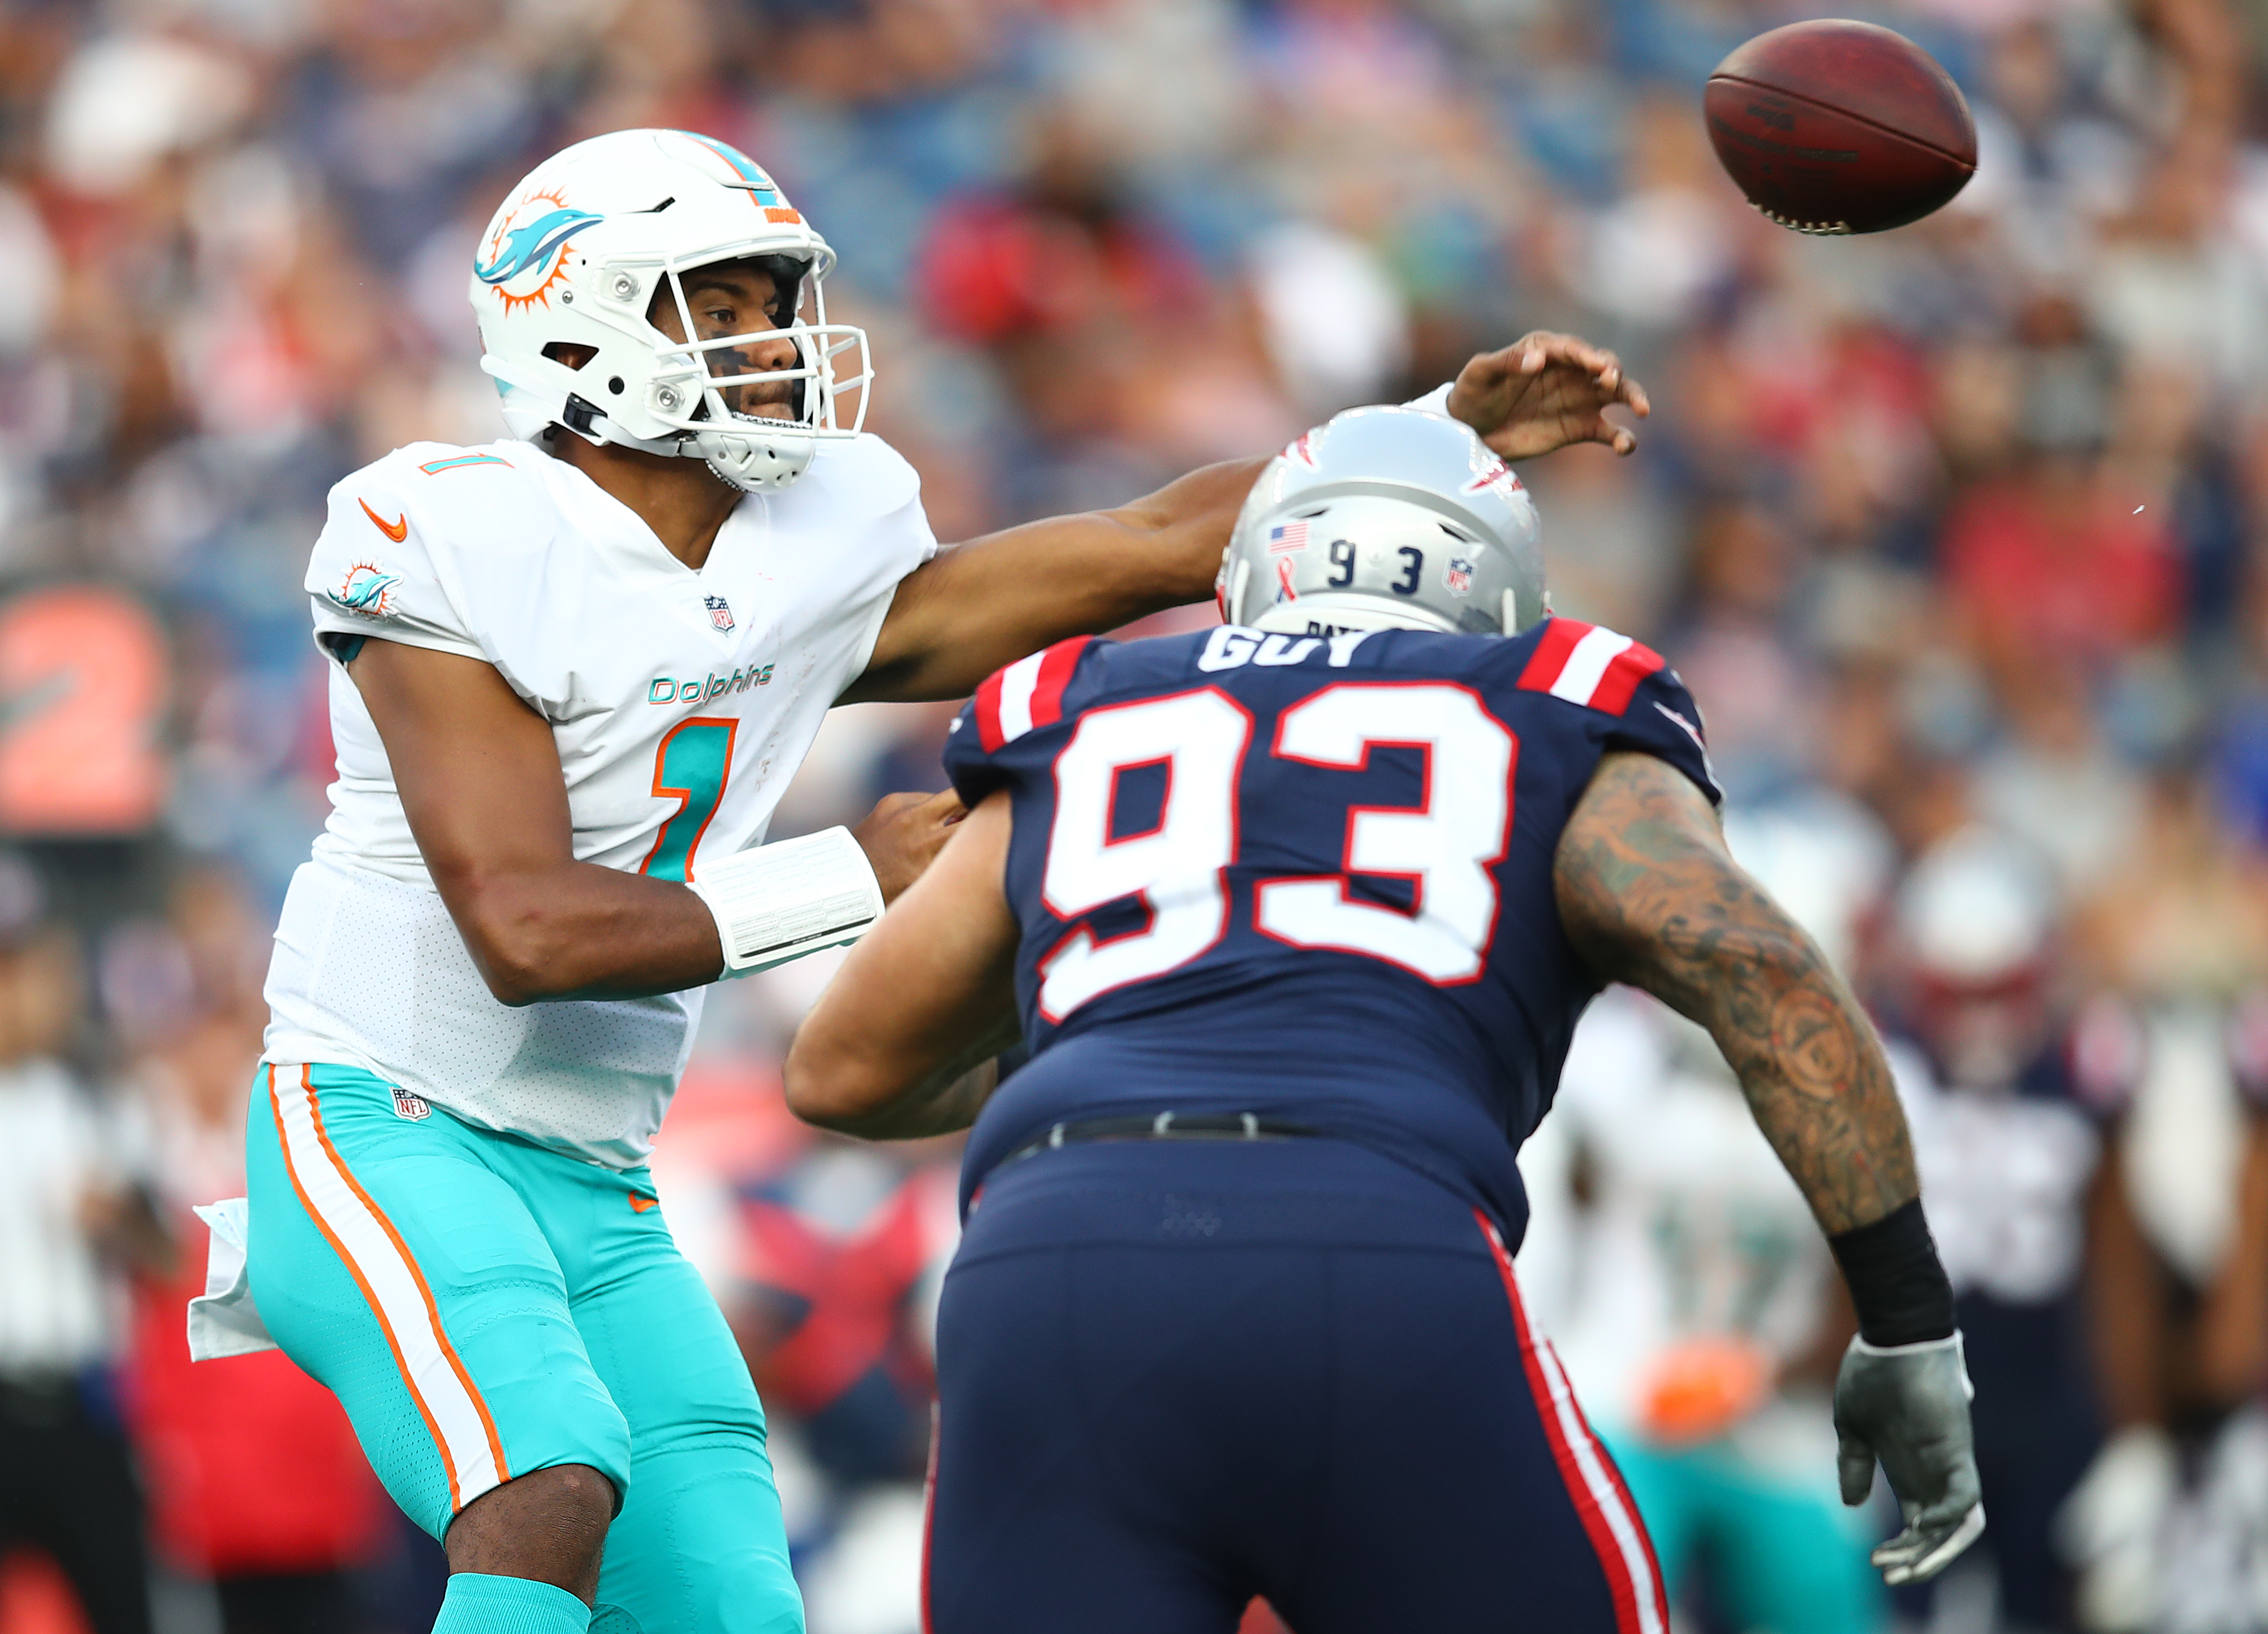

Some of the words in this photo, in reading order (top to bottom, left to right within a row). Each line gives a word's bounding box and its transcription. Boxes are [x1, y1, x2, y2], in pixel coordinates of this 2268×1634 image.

[711, 610, 733, 627] NFL
[1197, 624, 1372, 672] GUY
[648, 663, 775, 705] Dolphins
[639, 717, 740, 883] 1
[1036, 680, 1520, 1025] 93
[399, 1099, 426, 1115] NFL
